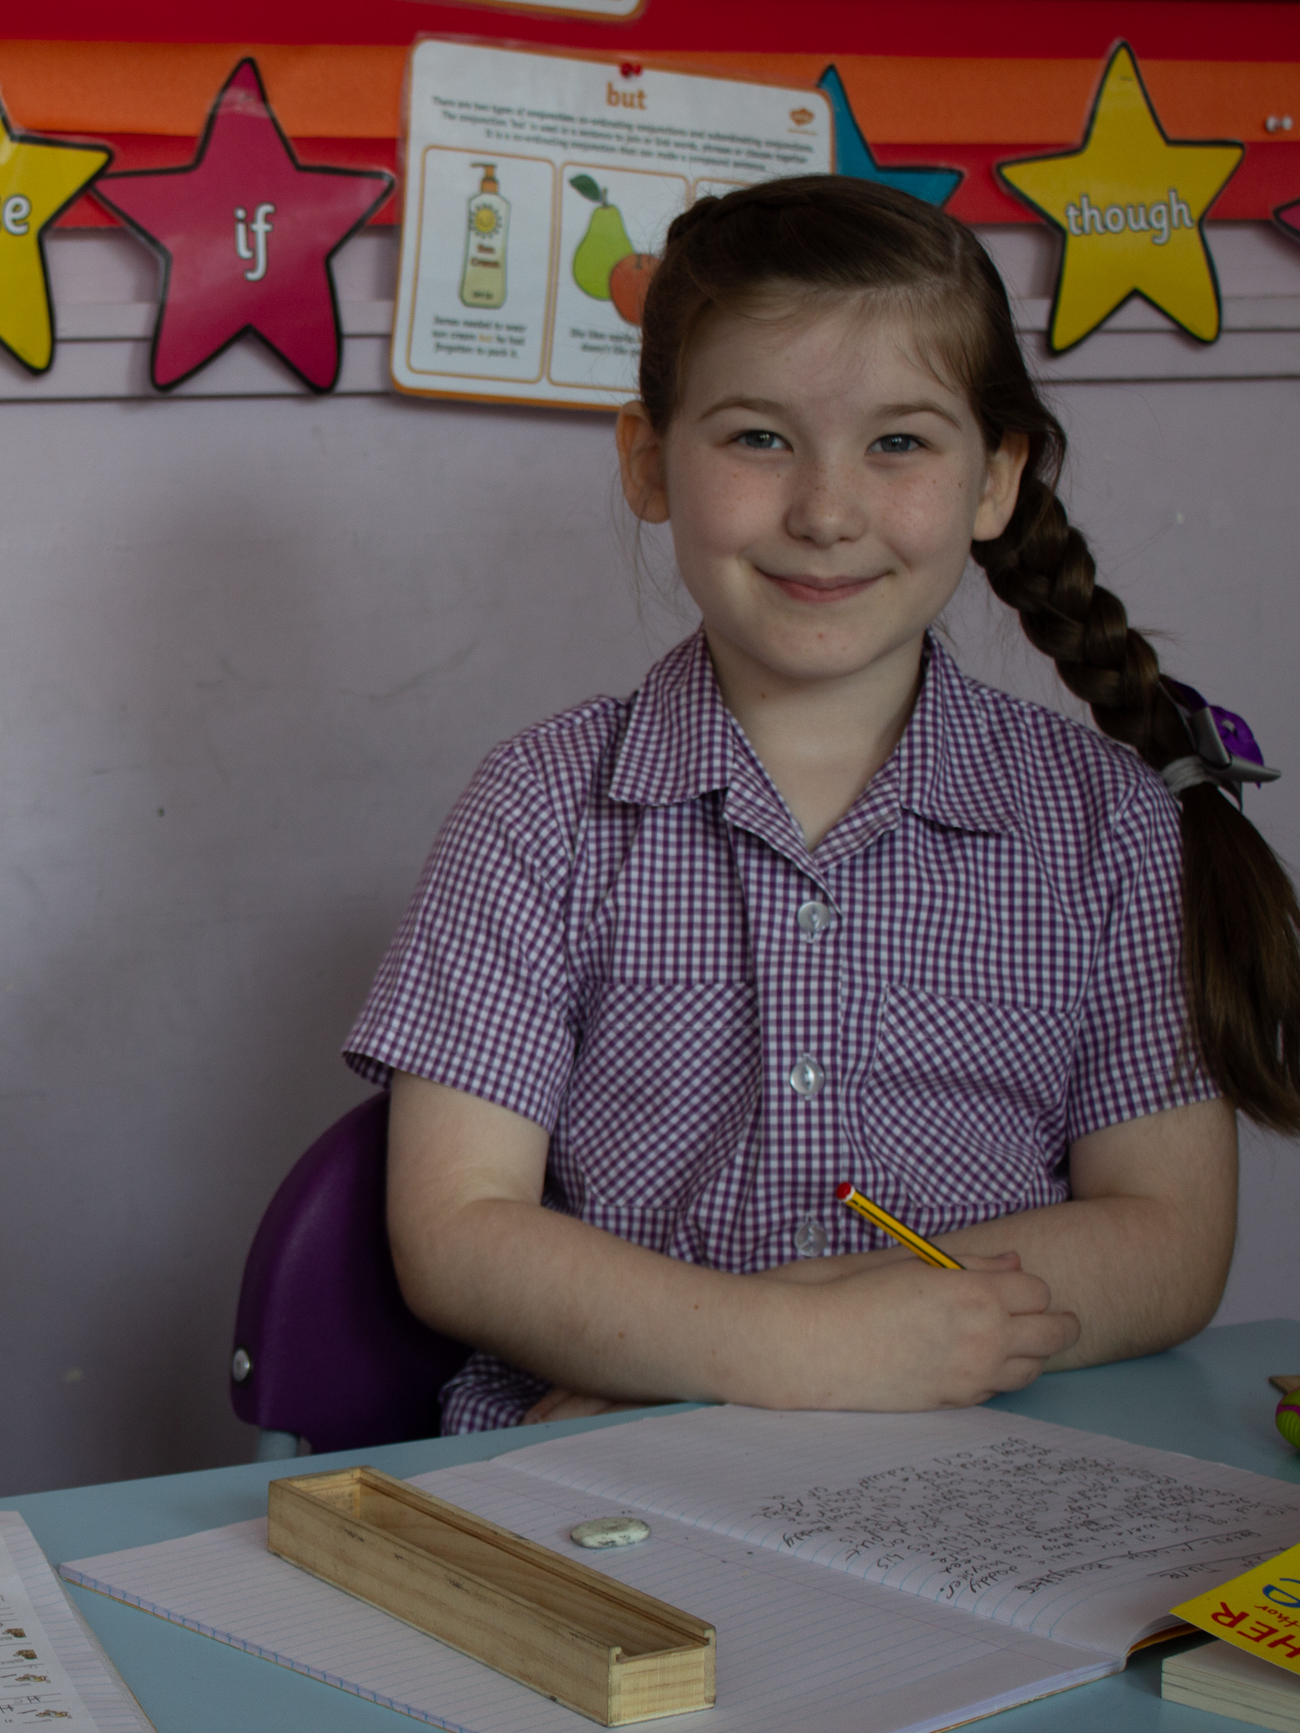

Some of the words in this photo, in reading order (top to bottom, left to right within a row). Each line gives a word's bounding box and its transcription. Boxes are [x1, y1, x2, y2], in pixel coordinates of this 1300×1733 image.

[605, 82, 647, 111] but
[1065, 188, 1194, 245] though
[234, 203, 275, 283] if
[876, 1553, 904, 1570] his
[939, 1554, 986, 1574] need
